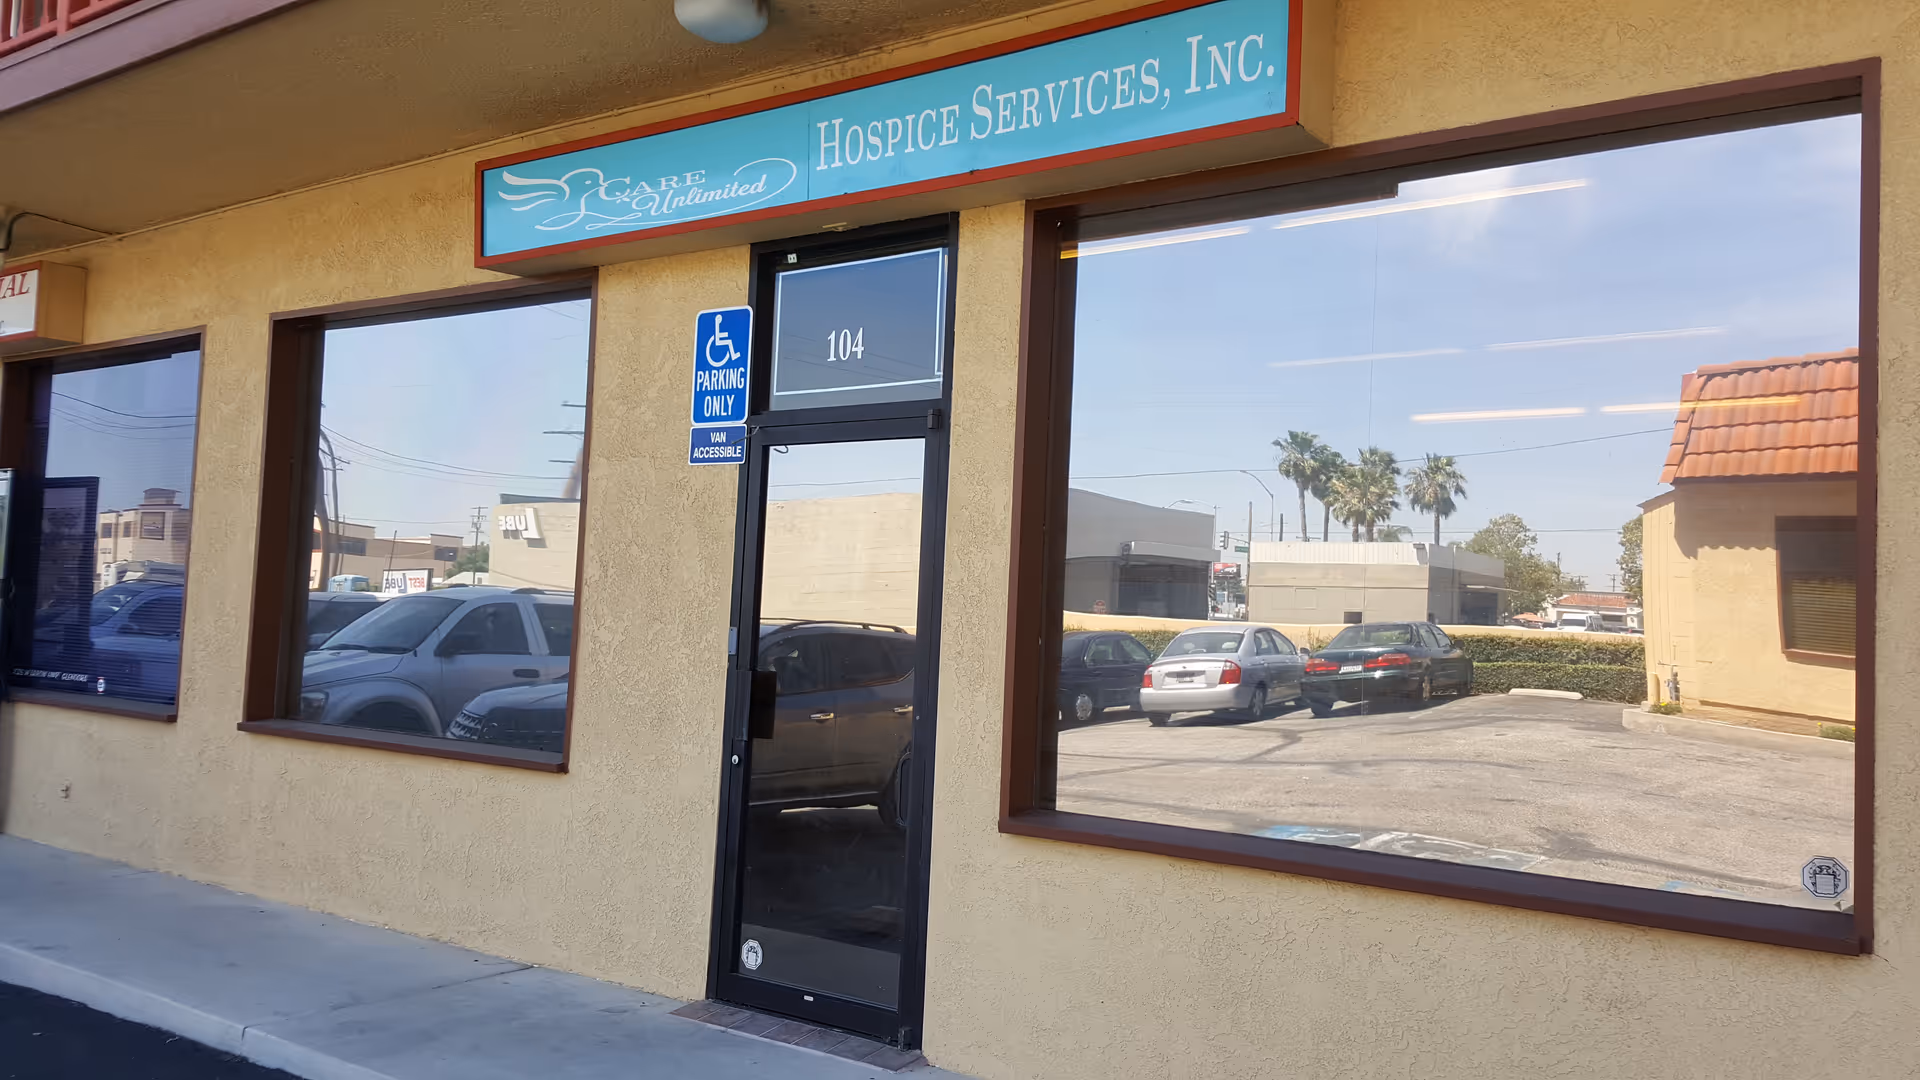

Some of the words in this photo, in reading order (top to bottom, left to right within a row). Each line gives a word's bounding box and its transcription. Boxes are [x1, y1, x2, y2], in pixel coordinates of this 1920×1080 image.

[815, 104, 961, 171] HOSPICE
[970, 58, 1171, 141] SERVICES,
[1184, 33, 1275, 95] INC.
[599, 170, 706, 201] CARE
[632, 174, 767, 216] Unlimited
[827, 327, 865, 362] 104
[696, 367, 745, 392] PARKING
[703, 394, 735, 417] ONLY
[710, 432, 727, 443] VAN
[692, 446, 742, 458] ACCESSIBLE
